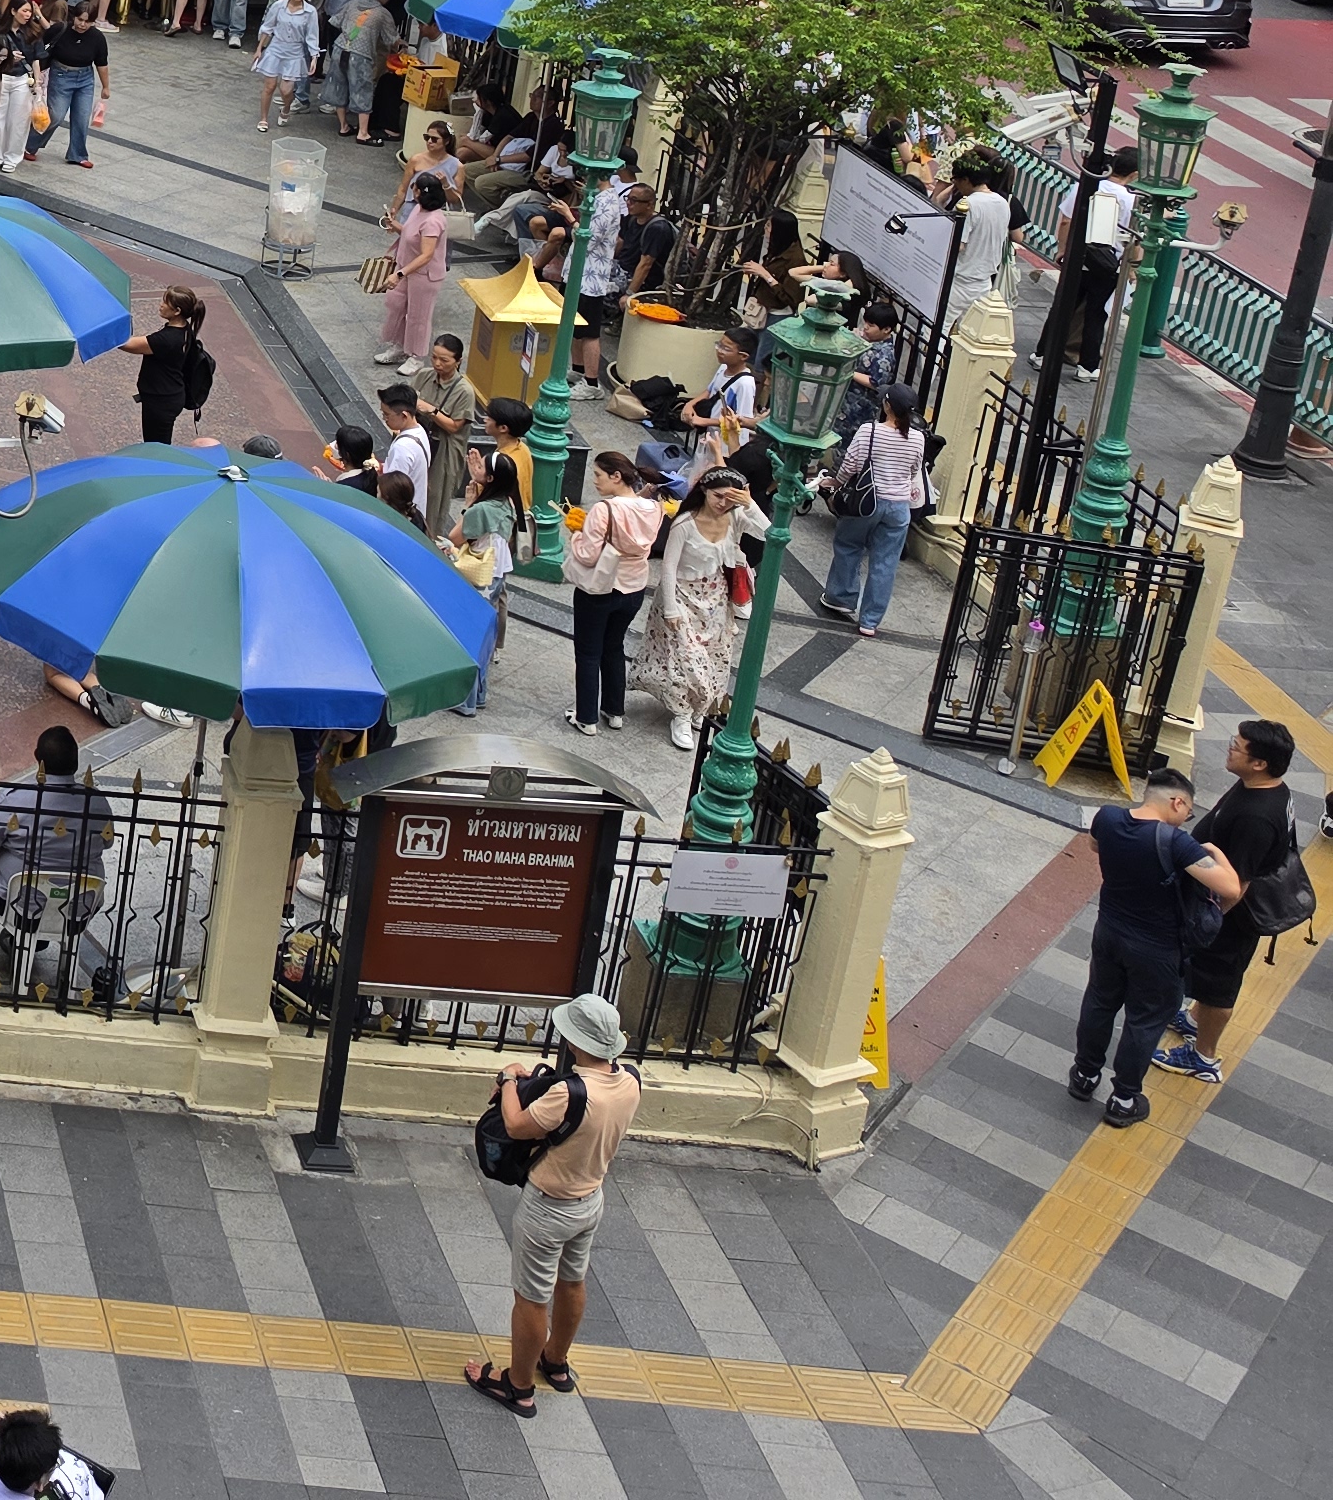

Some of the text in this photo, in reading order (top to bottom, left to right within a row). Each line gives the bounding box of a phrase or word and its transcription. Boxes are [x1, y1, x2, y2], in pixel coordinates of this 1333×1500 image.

[467, 809, 582, 842] ท้าวมหาพรหม
[463, 849, 575, 868] THAO MAHA BRAHMA
